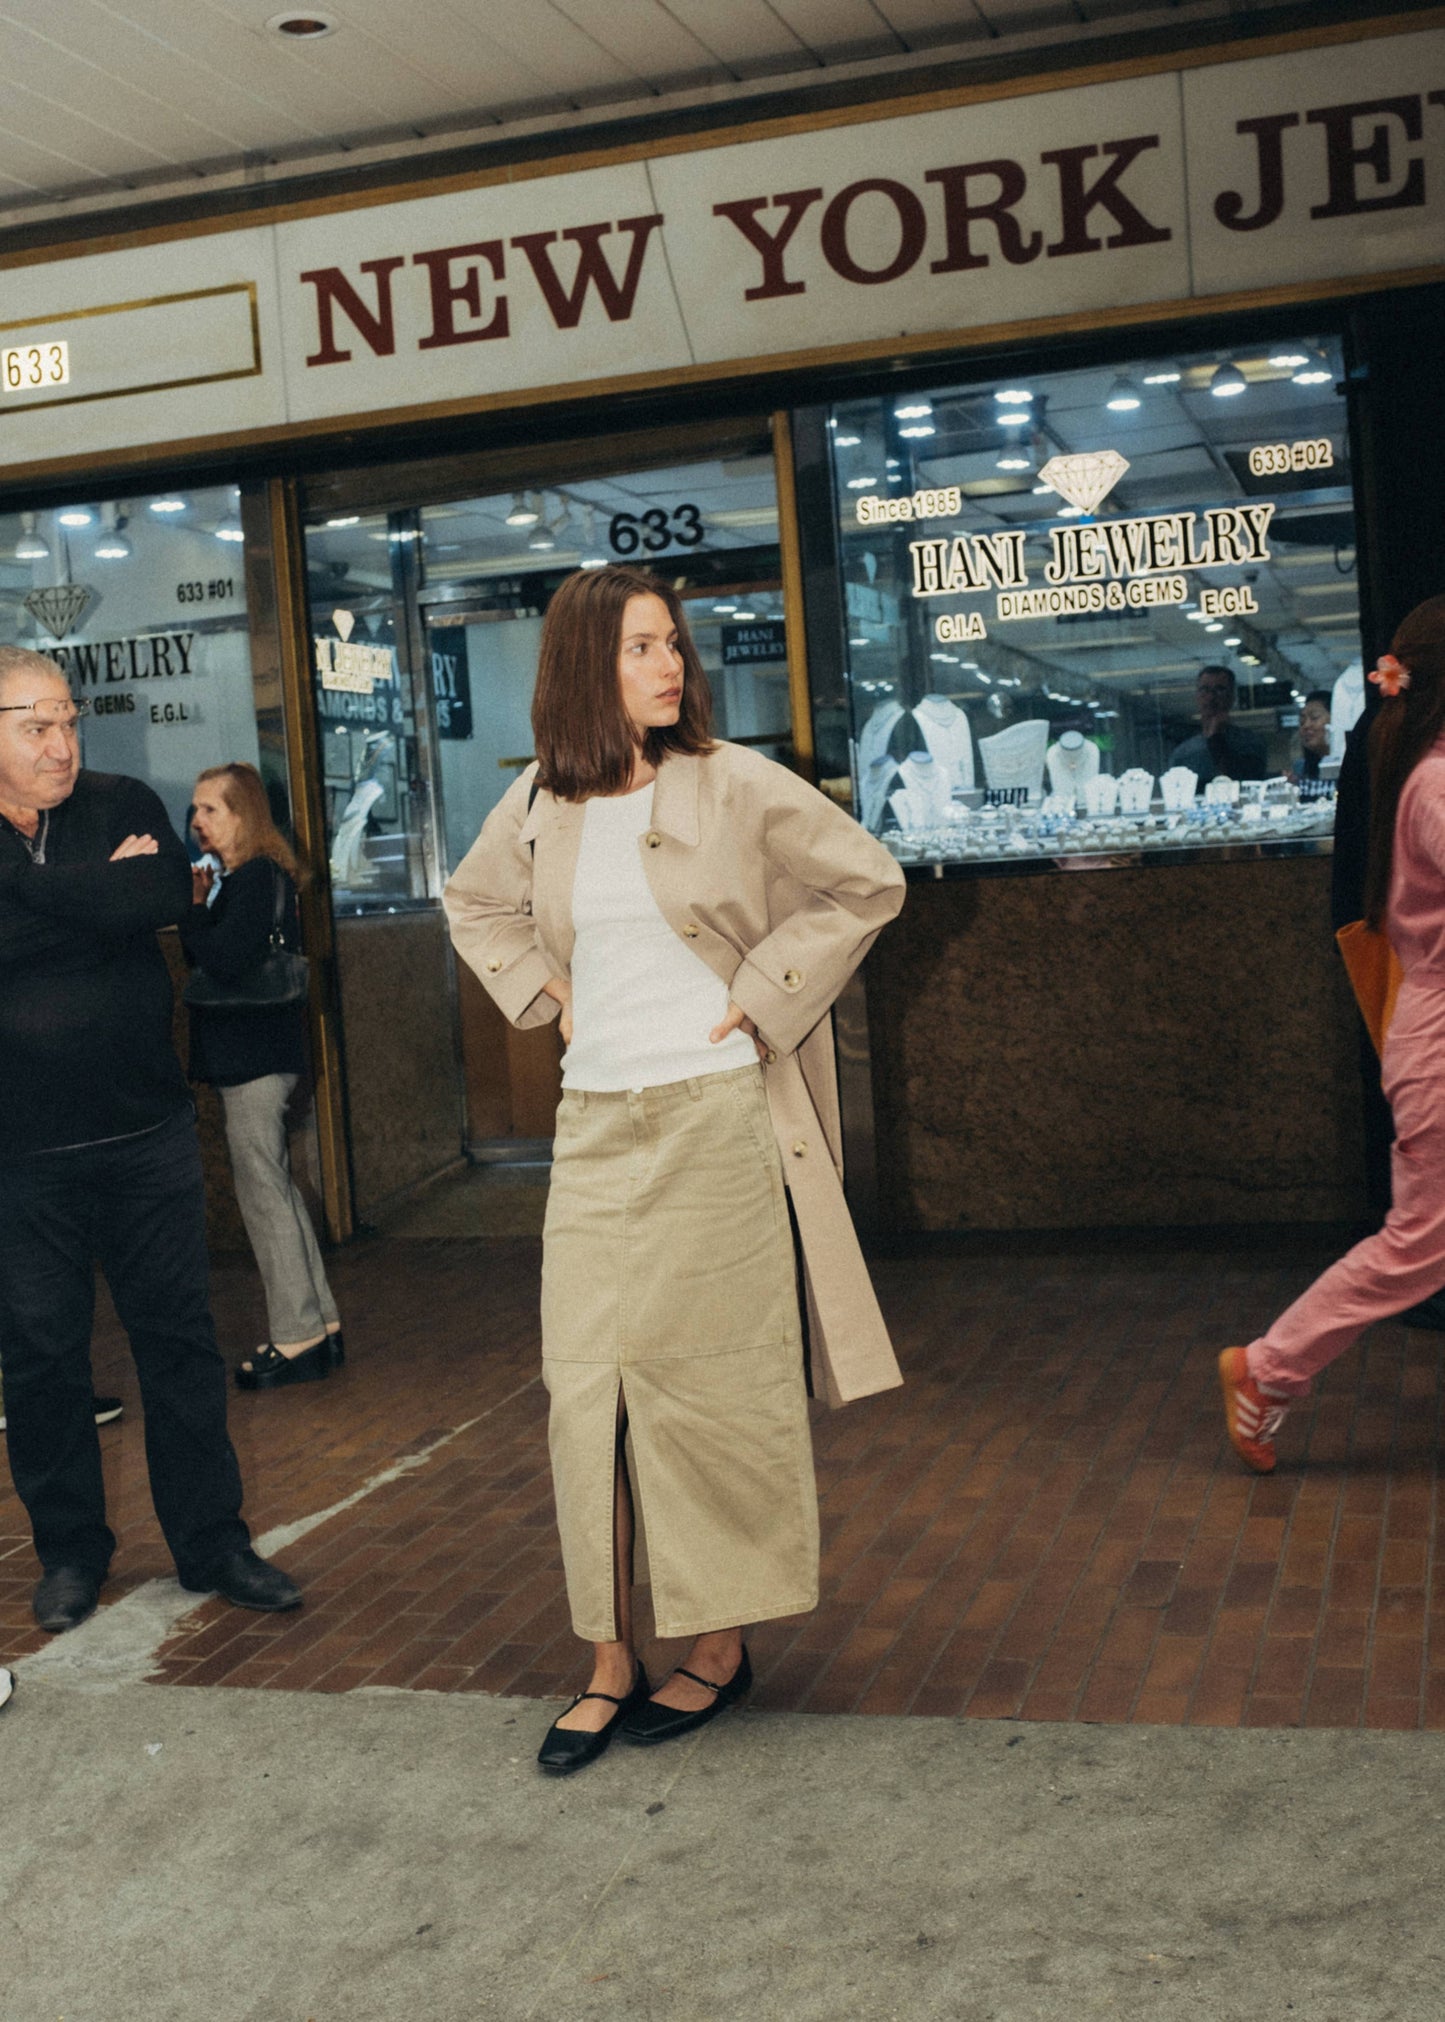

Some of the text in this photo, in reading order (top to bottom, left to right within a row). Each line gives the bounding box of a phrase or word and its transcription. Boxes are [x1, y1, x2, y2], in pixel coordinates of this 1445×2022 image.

[300, 90, 1445, 368] NEW YORK JE
[7, 345, 64, 387] 633
[1252, 442, 1329, 473] 633 #02
[859, 490, 959, 521] Since 1985
[609, 503, 704, 555] 633
[914, 506, 1271, 592] HANI JEWELRY
[176, 578, 234, 603] 633 #01
[1001, 578, 1184, 616] DIAMONDS & GEMS
[1204, 588, 1256, 614] E.G.L
[94, 692, 136, 716] GEMS
[150, 701, 189, 724] E.G.L
